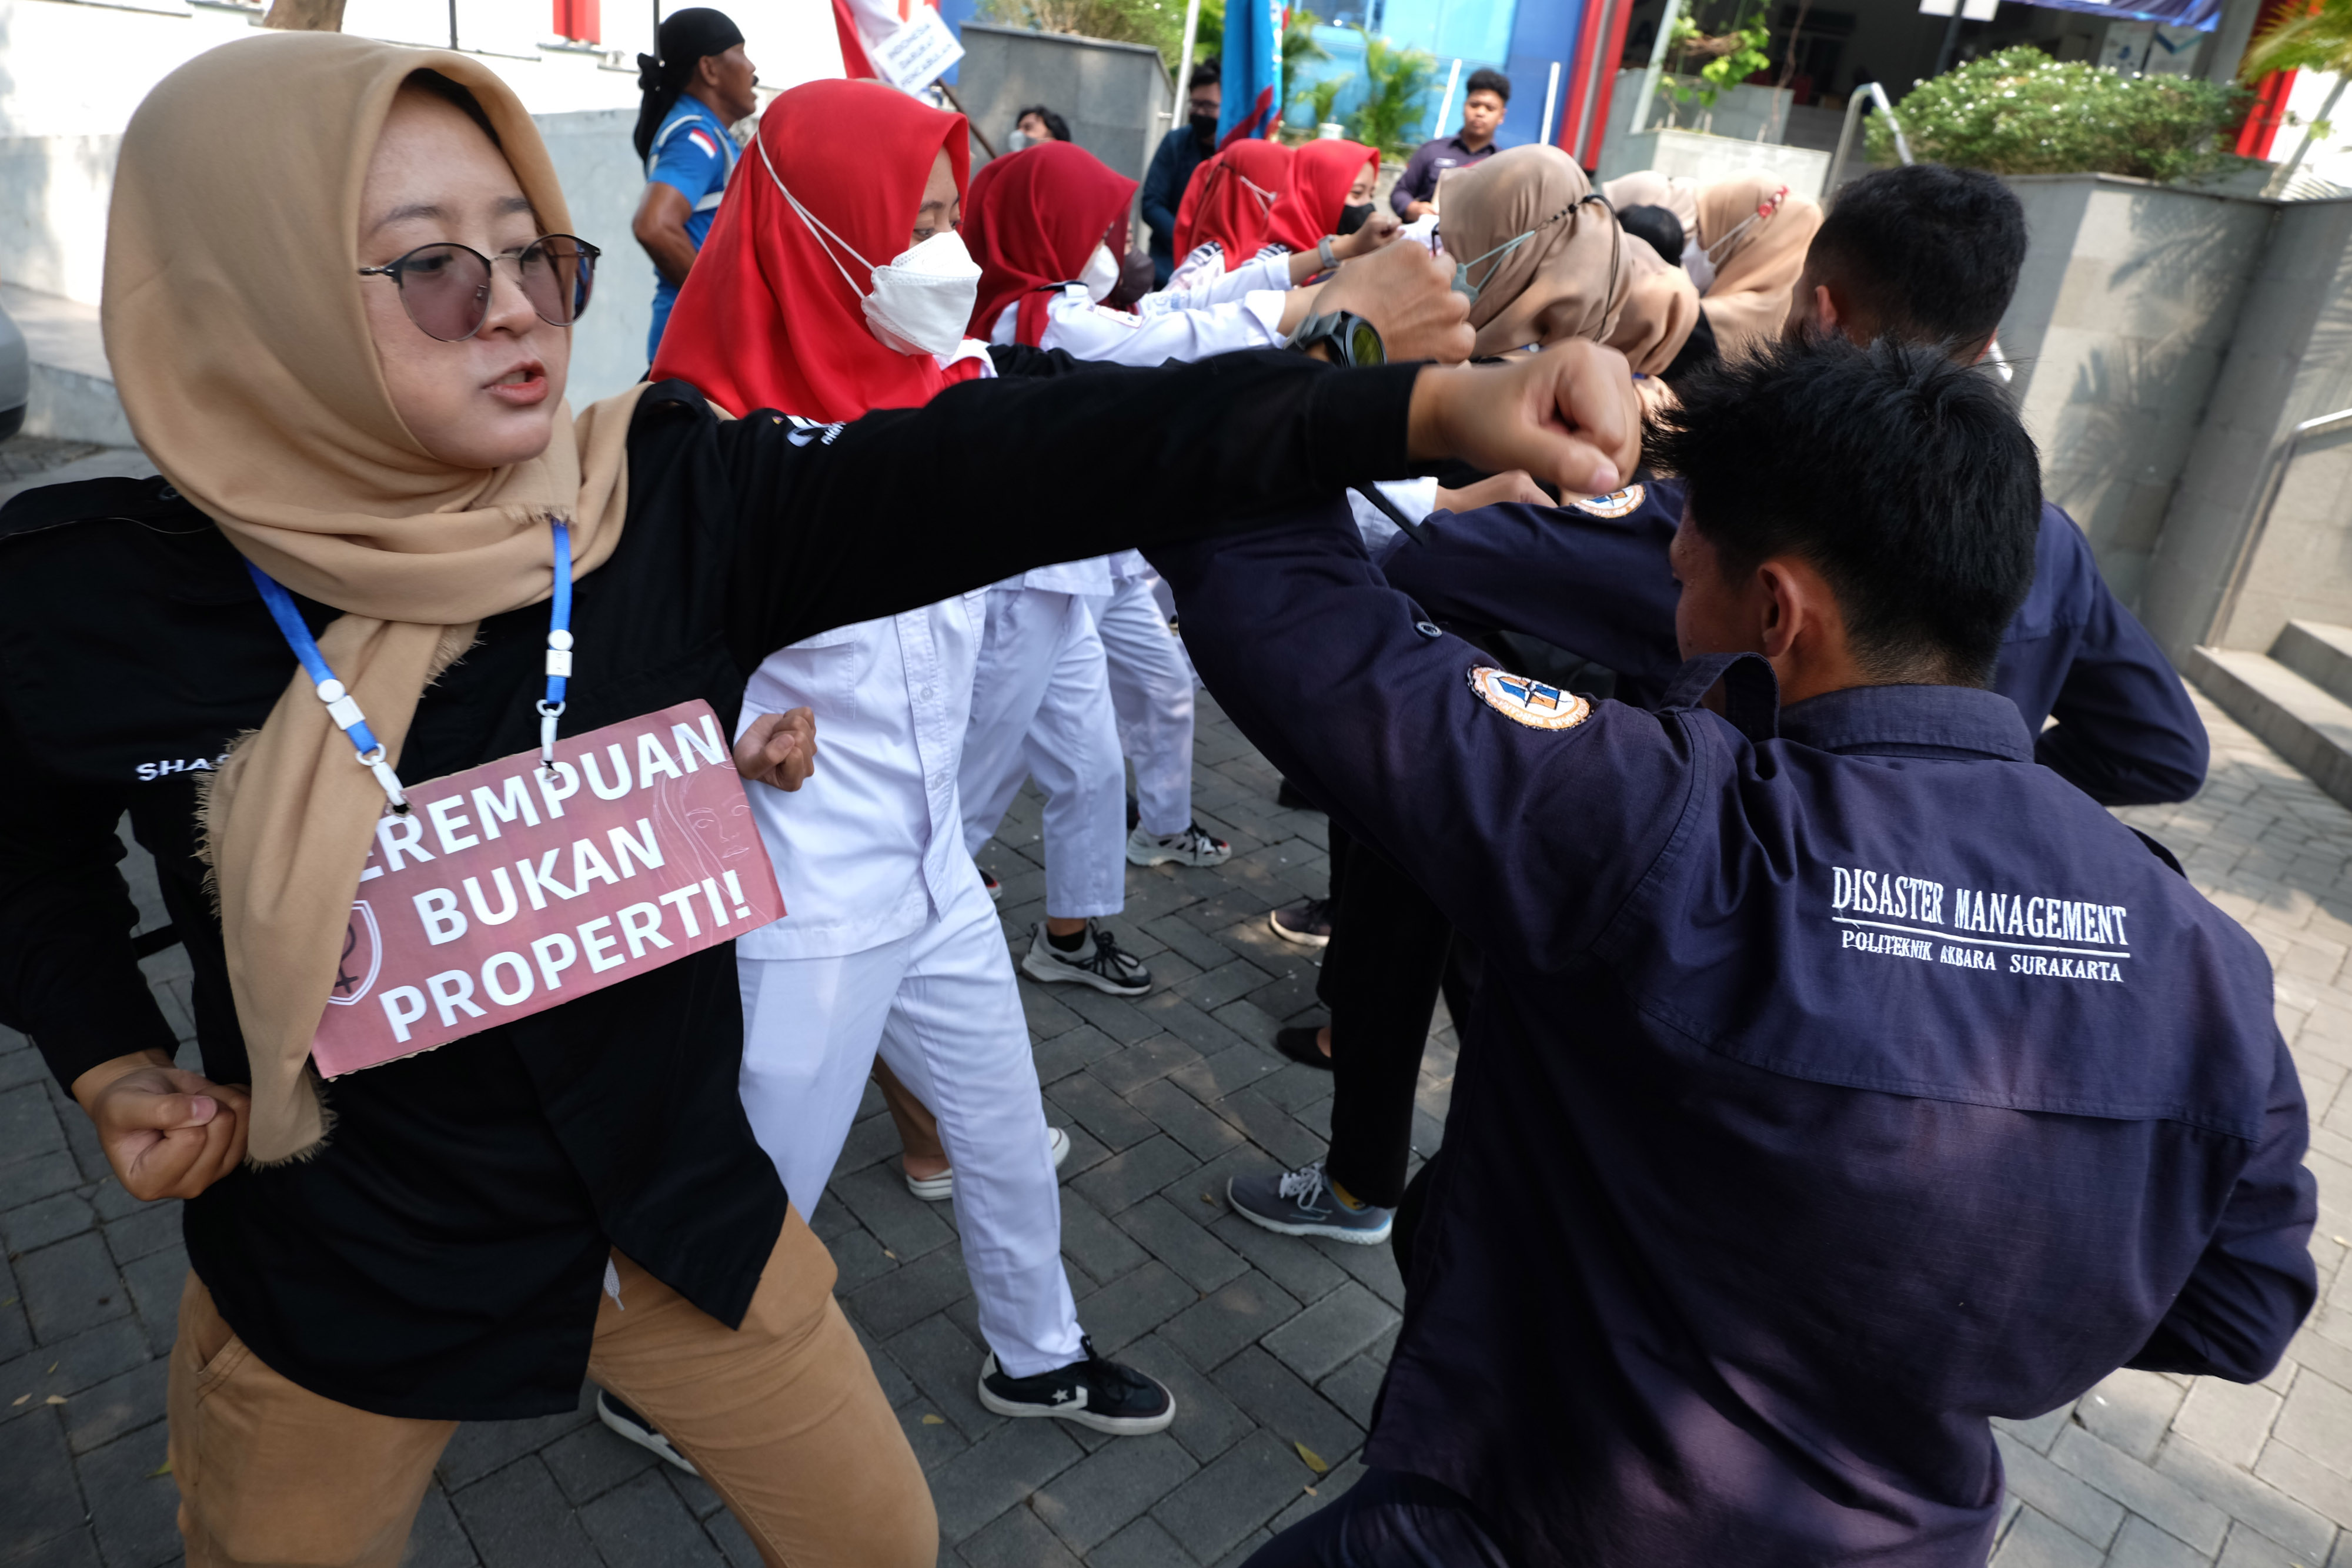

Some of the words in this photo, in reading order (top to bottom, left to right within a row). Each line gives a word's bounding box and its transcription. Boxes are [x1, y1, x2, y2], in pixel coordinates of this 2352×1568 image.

[412, 817, 666, 945] BUKAN
[1832, 866, 1945, 925] DISASTER
[1954, 888, 2129, 945] MANAGEMENT
[377, 869, 753, 1043] PROPERTI!
[1841, 930, 1933, 961] POLITEKNIK
[1940, 944, 1997, 971] AKBARA
[2009, 954, 2124, 982] SURAKARTA
